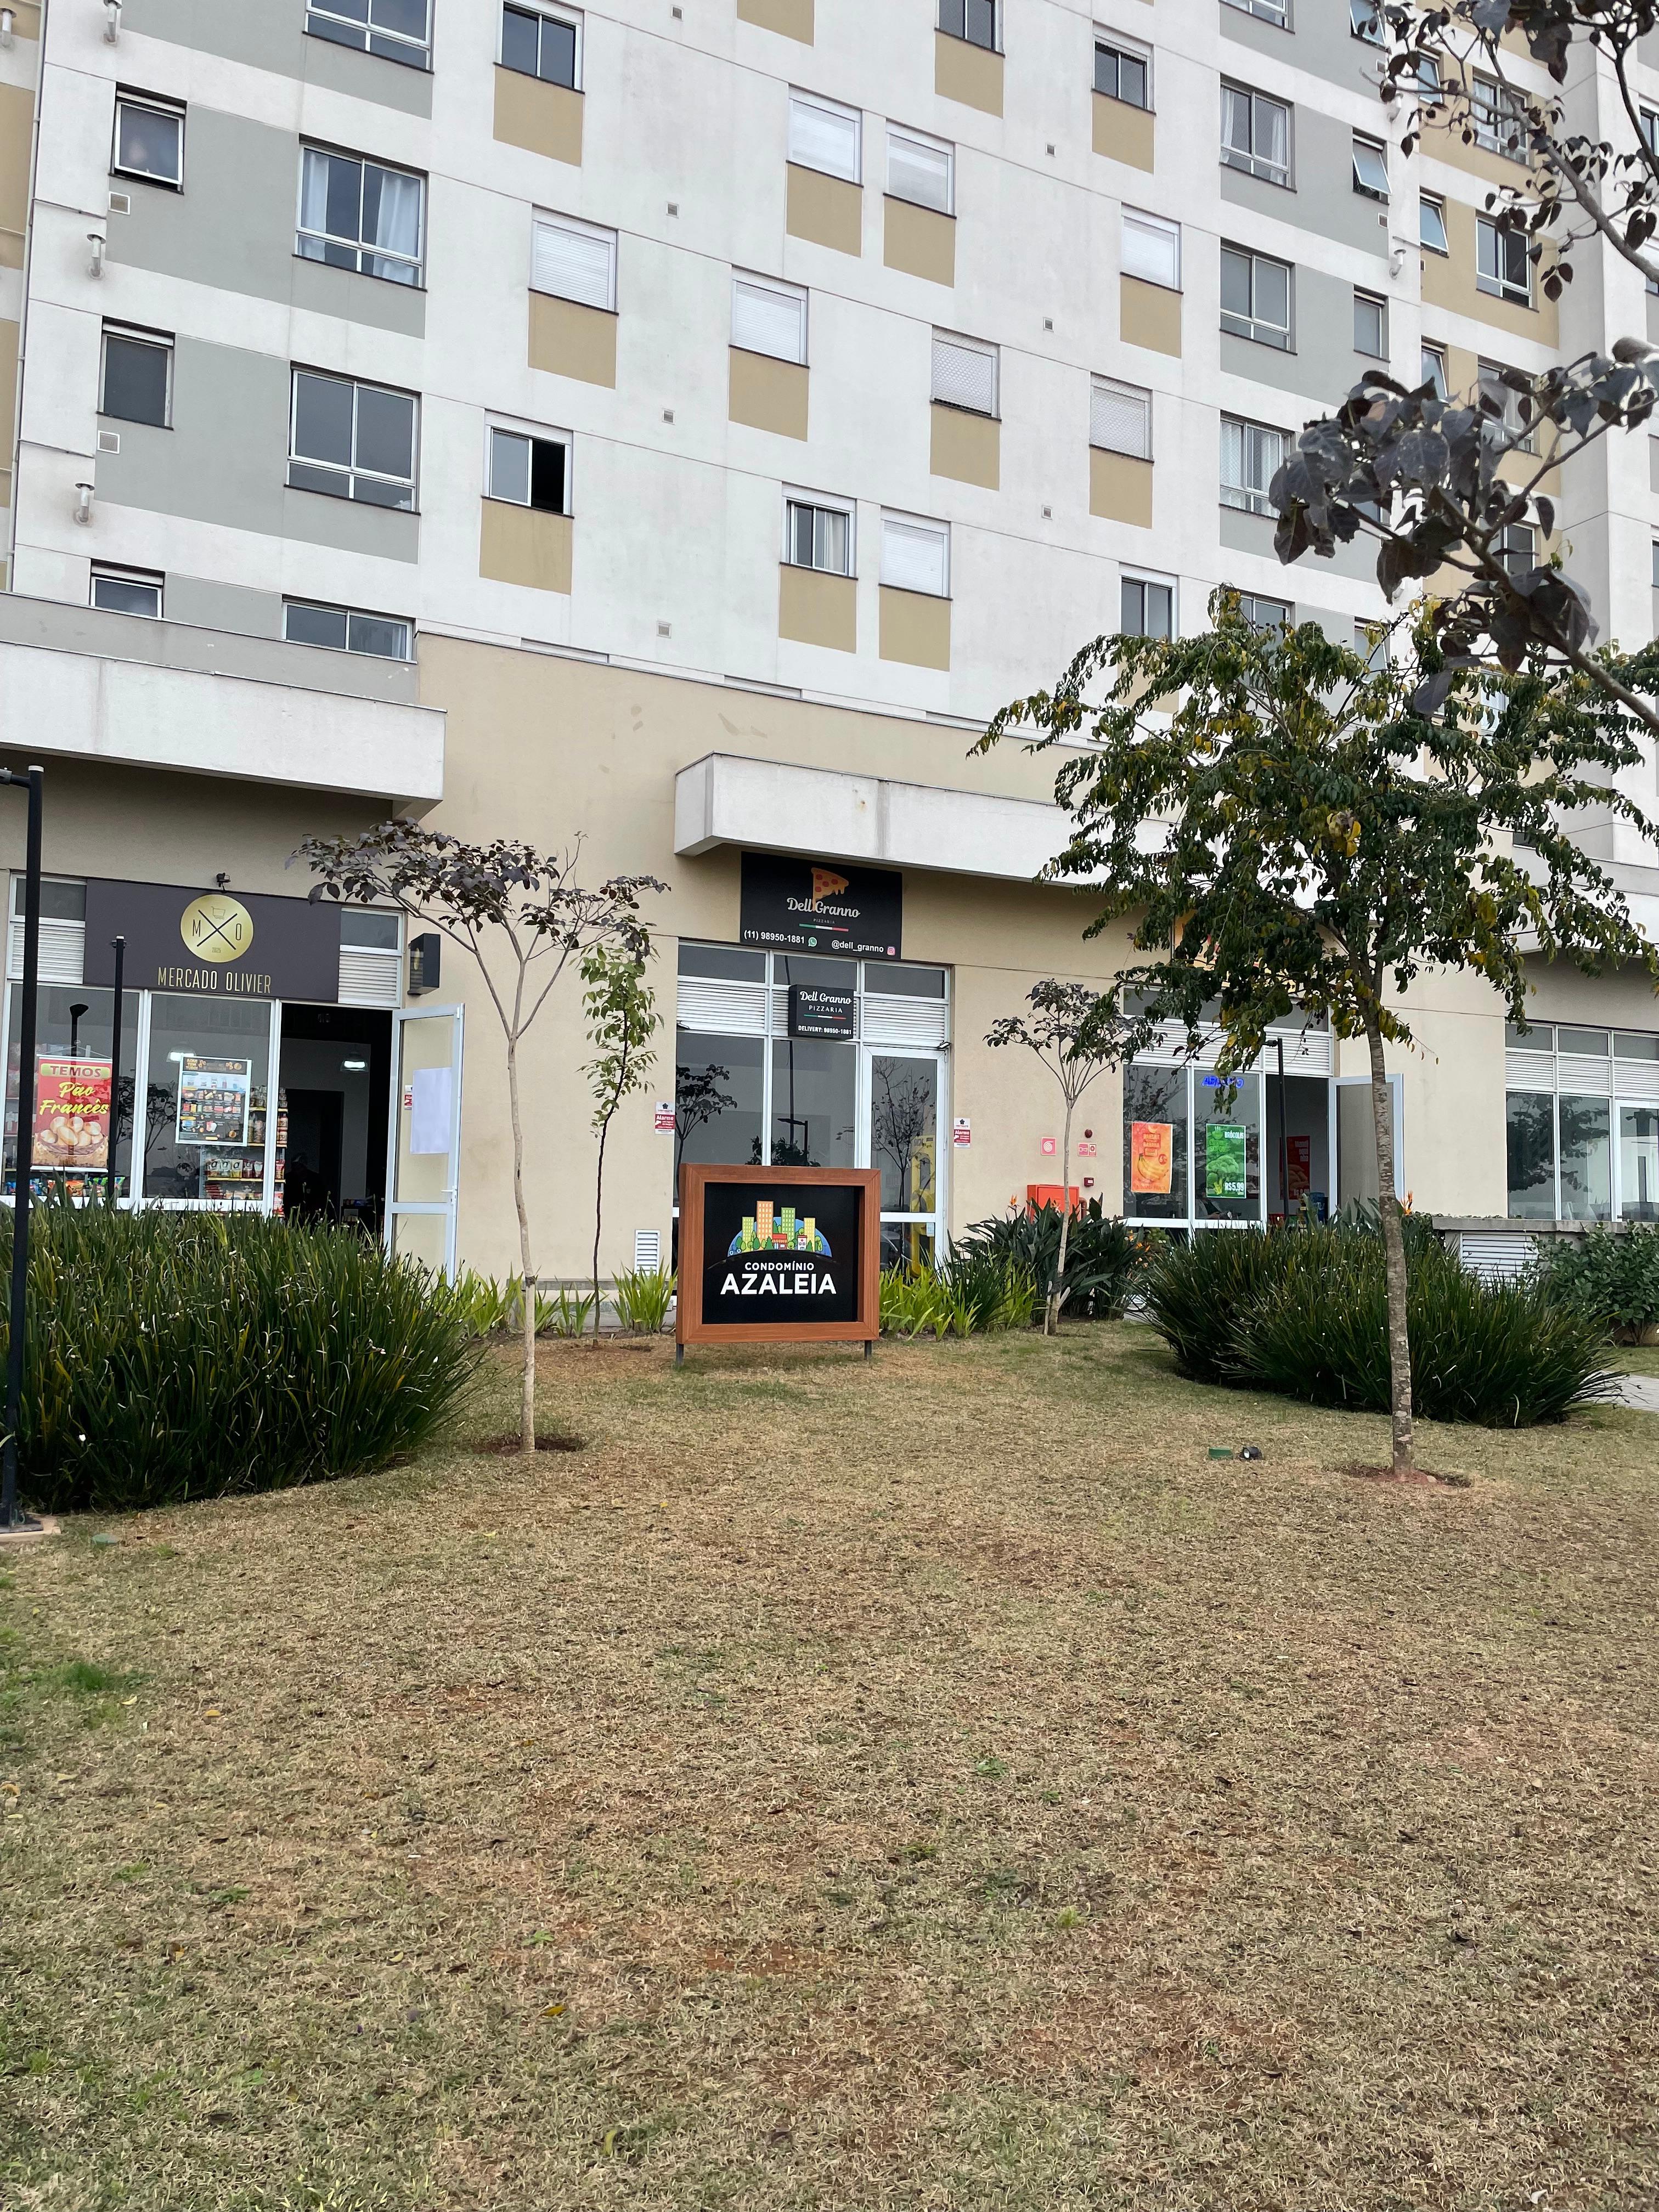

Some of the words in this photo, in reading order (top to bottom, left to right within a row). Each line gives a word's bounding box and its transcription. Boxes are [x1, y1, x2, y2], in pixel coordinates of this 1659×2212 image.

[787, 898, 813, 912] Dell
[815, 901, 860, 918] Granno
[744, 930, 759, 940] (11)
[761, 932, 805, 944] 98950-1881
[832, 940, 884, 953] @dell_granno
[158, 967, 217, 990] MERCADO
[225, 972, 271, 994] OLIVIER
[799, 991, 818, 1001] Dell
[820, 992, 852, 1005] Granno
[809, 1005, 843, 1013] PIZZARIA
[50, 1066, 101, 1077] TEMOS
[59, 1081, 96, 1098] Pão
[39, 1098, 110, 1115] Francês
[1224, 1130, 1244, 1139] BRÓCOLIS
[1224, 1182, 1244, 1192] R$5,99
[744, 1260, 814, 1271] CONDOMÍNIO
[720, 1273, 837, 1295] AZALEIA
